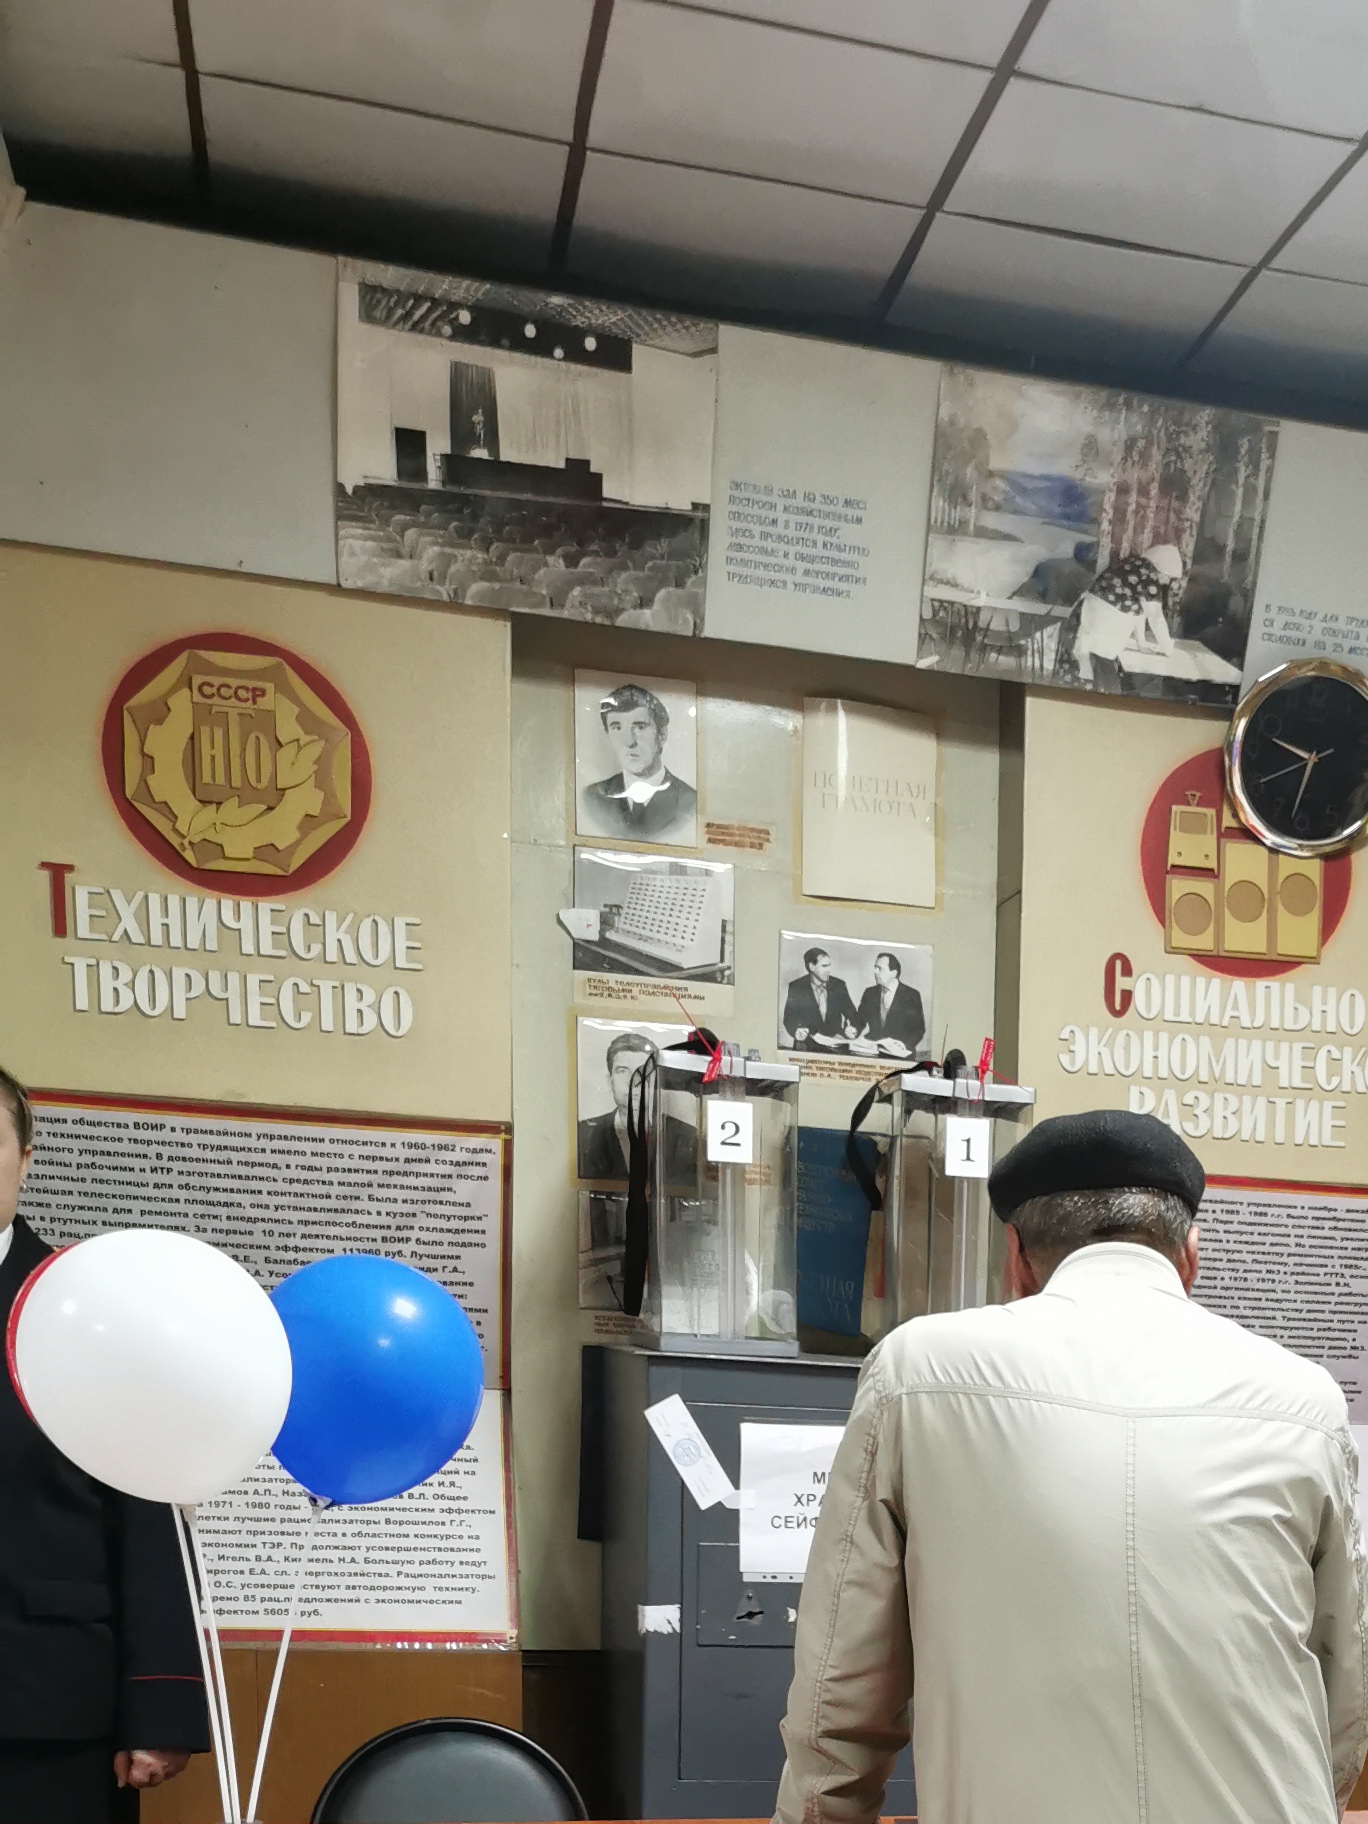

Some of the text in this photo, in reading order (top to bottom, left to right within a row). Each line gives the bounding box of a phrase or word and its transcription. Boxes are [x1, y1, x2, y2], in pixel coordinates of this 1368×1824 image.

[198, 681, 266, 706] СССР
[38, 861, 423, 970] ТЕХНИЧЕСКОЕ
[62, 956, 413, 1038] ТВОРЧЕСТВО
[1104, 952, 1365, 1036] СОЦИАЛЬНО
[1128, 1086, 1347, 1148] РАЗВИТИЕ
[72, 1118, 130, 1130] общества
[134, 1122, 166, 1132] ВОИР
[180, 1126, 252, 1138] трамвайном
[256, 1132, 325, 1144] управлении
[329, 1138, 387, 1148] относится
[720, 1122, 742, 1147] 2
[46, 1130, 124, 1144] техническое
[128, 1137, 193, 1150] творчество
[198, 1143, 266, 1154] трудящихся
[270, 1148, 306, 1157] имело
[310, 1152, 344, 1160] место
[358, 1155, 400, 1164] первых
[404, 1156, 431, 1165] дней
[960, 1137, 976, 1163] 1
[34, 1158, 456, 1194] войны рабочими изготавливались средства малой механизации,
[78, 1148, 490, 1182] управления. довоенный период, годы развития предприятия после
[76, 1190, 180, 1204] телескопическая
[184, 1198, 246, 1210] площадка,
[274, 1204, 372, 1216] устанавливалась
[385, 1210, 418, 1220] кузов
[90, 1176, 472, 1208] лестницы для обслуживания контактной сети. Была изготовлена
[50, 1216, 486, 1249] ртутных первые 10 деятельности ВОИР подано
[56, 1203, 486, 1236] служила ремонта внедрялись приспособления охлаждения
[274, 1244, 334, 1254] эффектом
[410, 1252, 462, 1261] Лучшими
[245, 1502, 270, 1510] 1980
[347, 1505, 435, 1514] экономическим
[438, 1507, 496, 1515] эффектом
[432, 1493, 468, 1502] Общее
[233, 1515, 446, 1527] лучшие Ворошилов
[350, 1530, 464, 1541] областном конкурсе
[365, 1544, 482, 1553] усовершенствование
[364, 1557, 416, 1566] Большую
[418, 1558, 456, 1568] работу
[459, 1560, 488, 1568] ведут
[396, 1571, 496, 1580] Рационализаторы
[344, 1584, 481, 1594] автодорожную технику.
